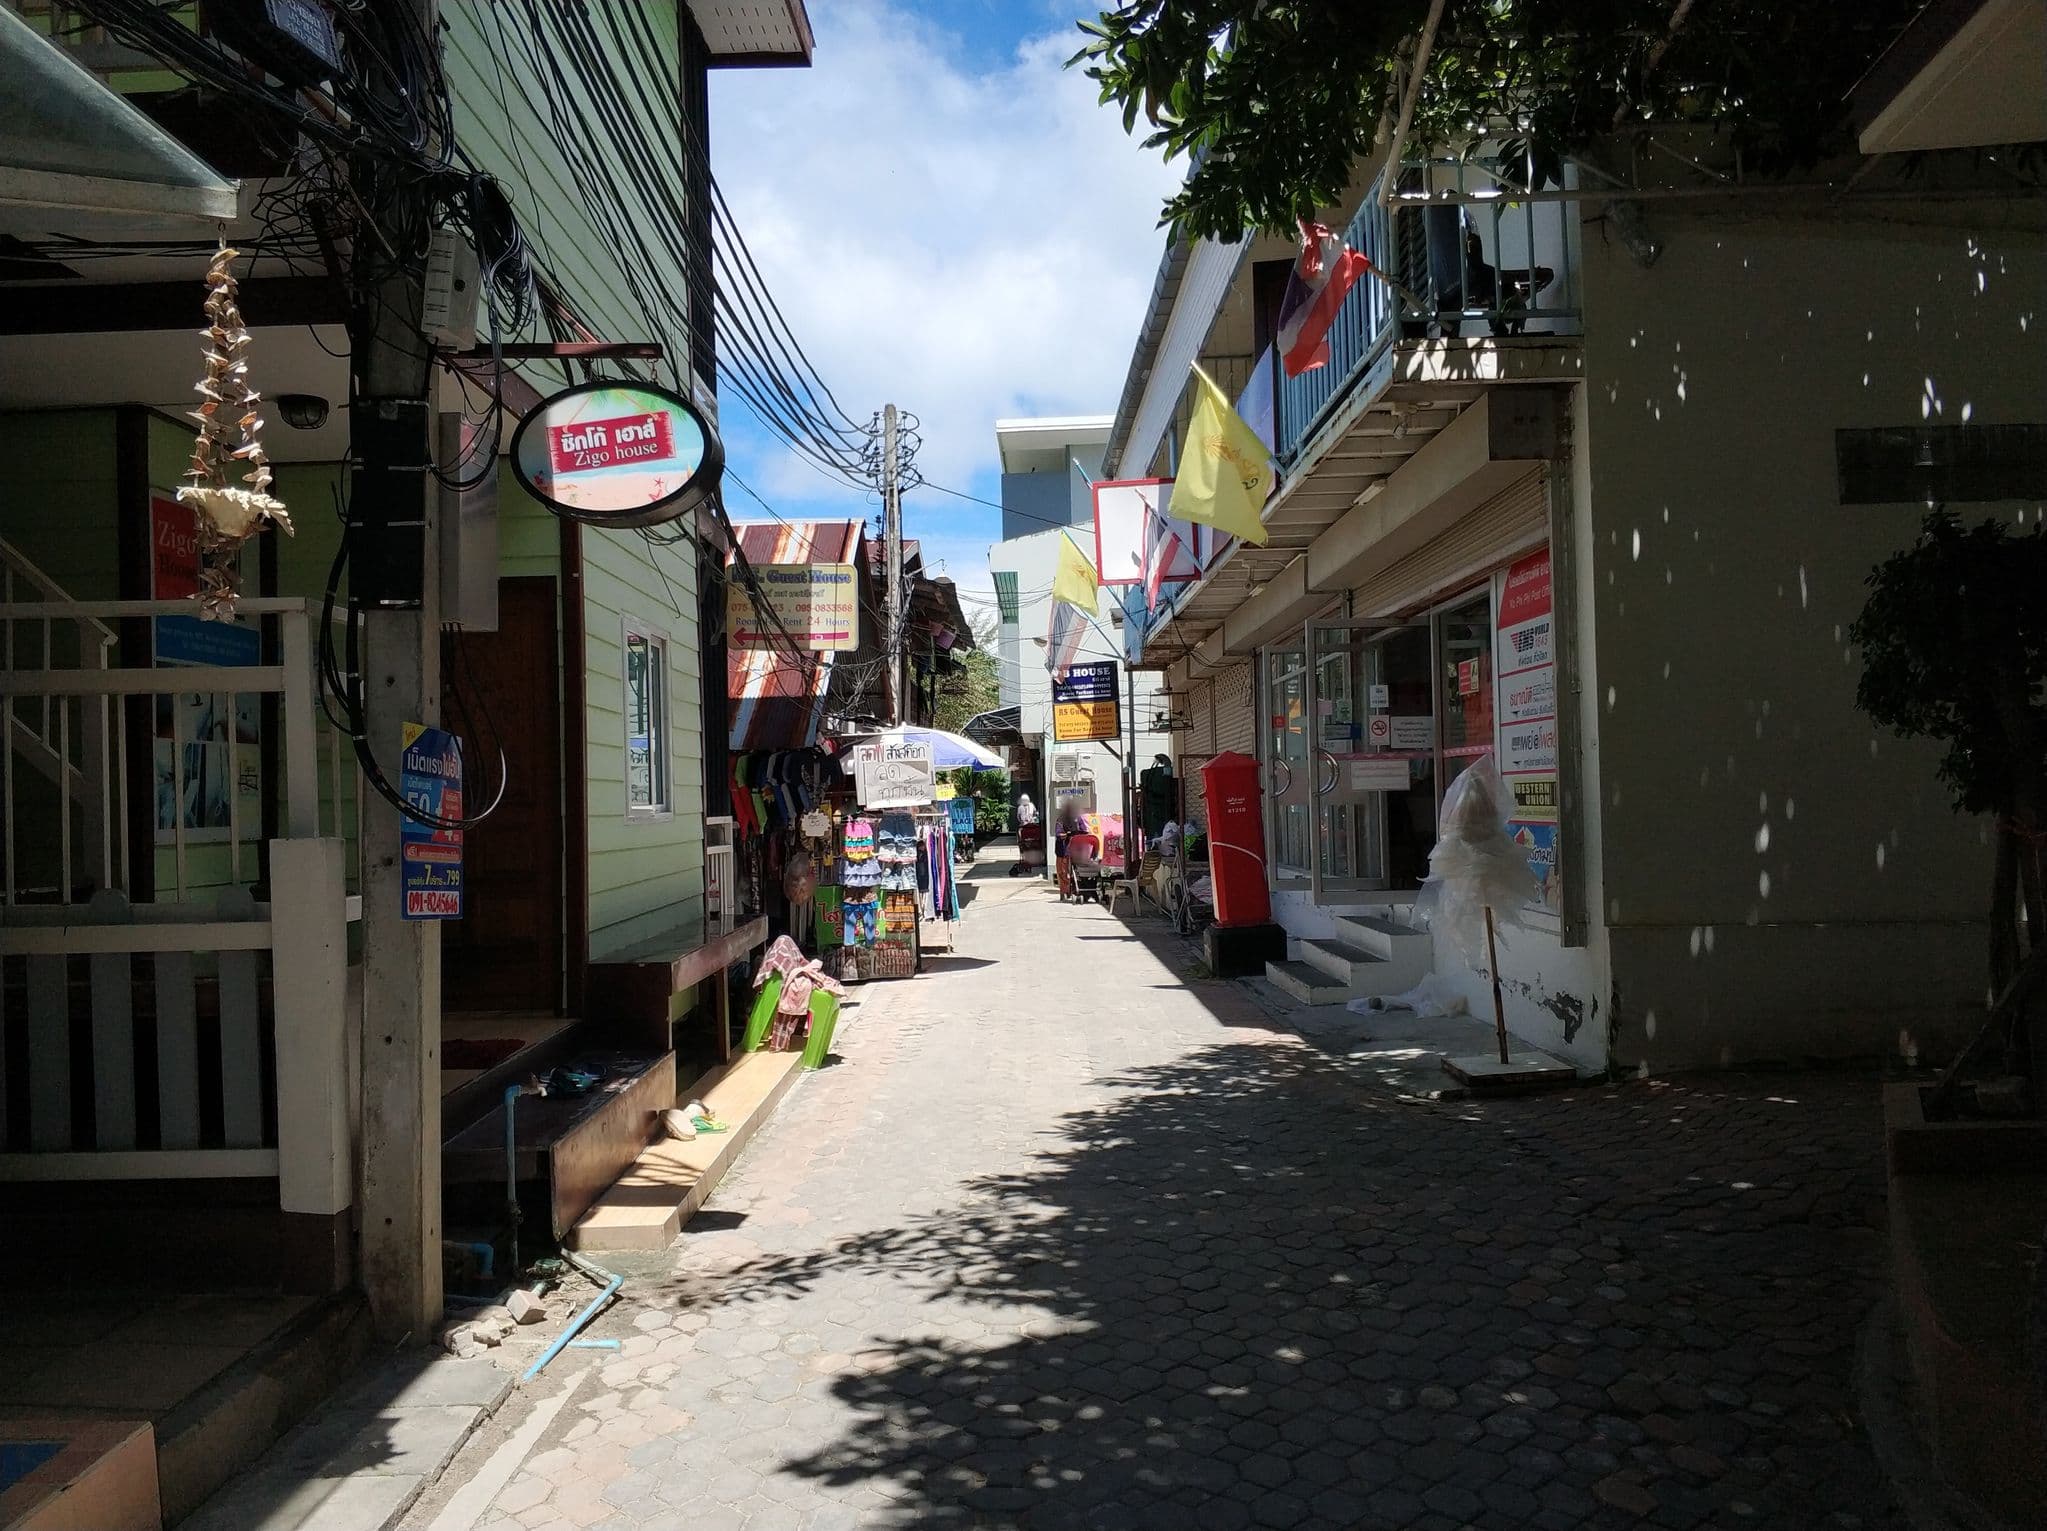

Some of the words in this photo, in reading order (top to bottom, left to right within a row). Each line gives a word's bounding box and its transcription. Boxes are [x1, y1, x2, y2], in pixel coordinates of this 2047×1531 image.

[615, 418, 656, 444] เฮาส์
[574, 448, 610, 467] Zigo
[615, 442, 658, 460] house
[767, 569, 807, 583] Guest
[808, 569, 851, 583] House
[783, 617, 802, 626] Rent
[807, 616, 820, 626] 24
[825, 617, 850, 626] Hours
[1073, 667, 1111, 678] HOUSE
[1514, 783, 1551, 794] WESTERN
[1525, 794, 1551, 806] UNION
[952, 817, 972, 825] PLACE
[446, 869, 460, 886] 799
